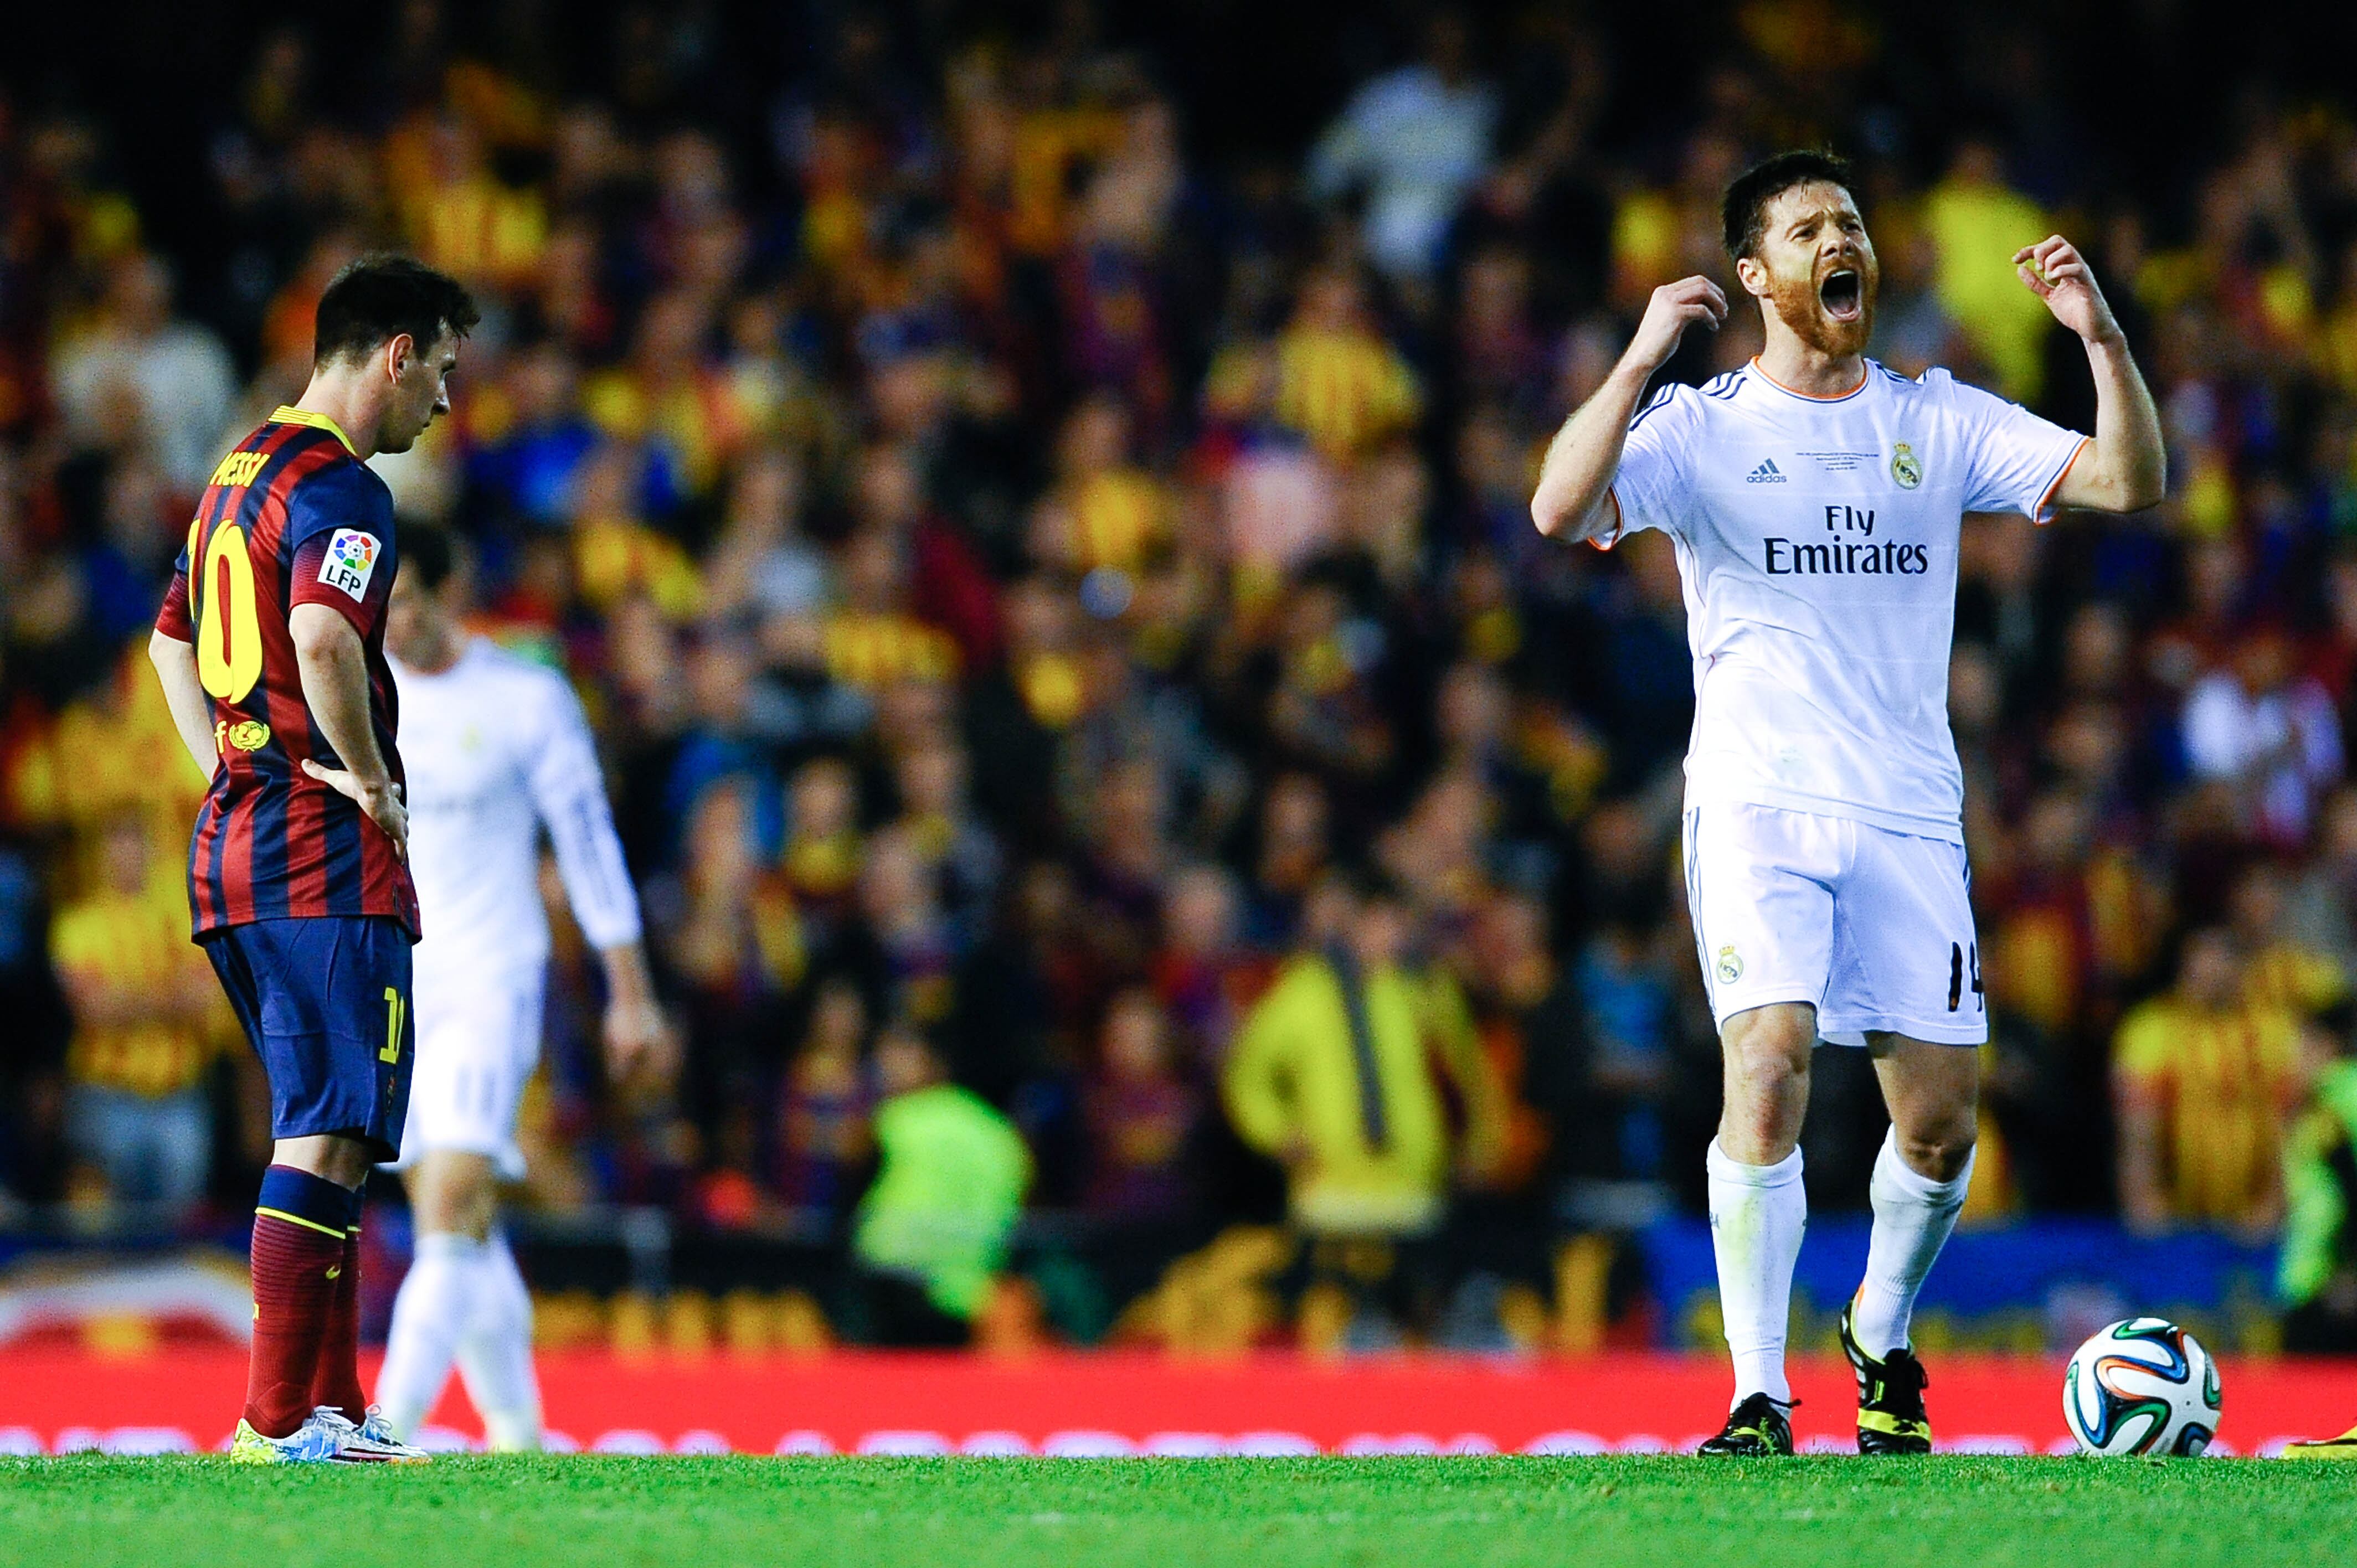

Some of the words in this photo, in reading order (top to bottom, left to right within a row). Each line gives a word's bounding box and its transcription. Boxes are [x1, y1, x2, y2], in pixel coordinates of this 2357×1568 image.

[209, 451, 270, 487] MESSI
[1747, 473, 1787, 483] adidas
[1824, 506, 1875, 536] Fly
[1763, 535, 1928, 574] Emirates
[326, 565, 361, 592] LFP
[379, 987, 404, 1064] 1
